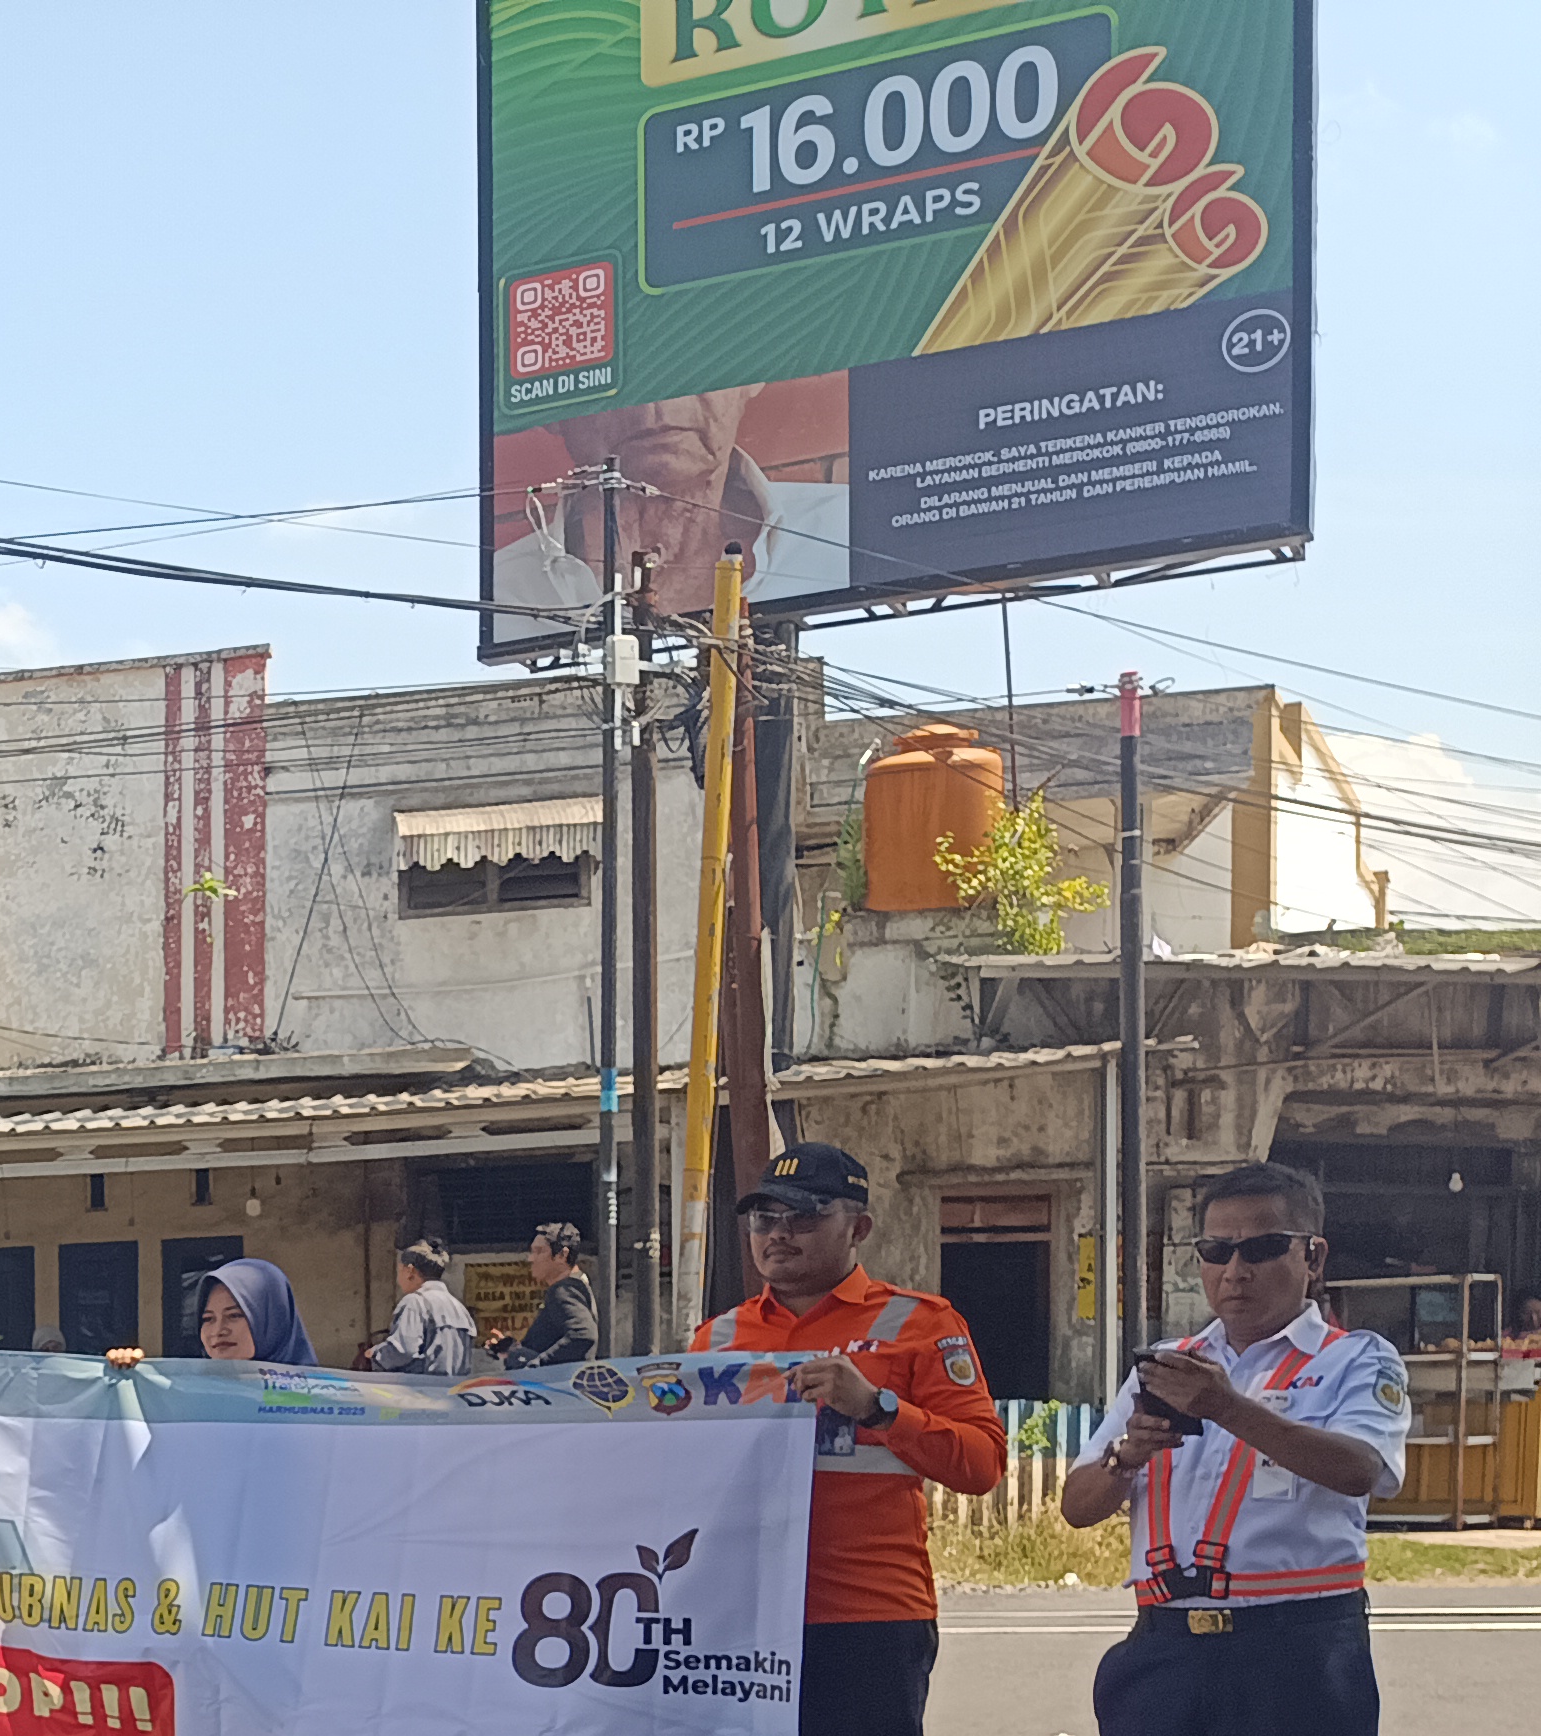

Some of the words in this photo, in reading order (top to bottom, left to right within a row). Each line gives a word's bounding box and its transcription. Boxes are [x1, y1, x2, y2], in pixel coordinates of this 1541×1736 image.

[676, 117, 726, 154] RP
[740, 45, 1059, 194] 16.000
[760, 219, 803, 254] 12
[817, 182, 981, 243] WRAPS
[1231, 328, 1285, 356] 21+
[510, 378, 554, 403] SCAN
[558, 374, 575, 393] DI
[578, 366, 611, 389] SINI
[978, 380, 1164, 430] PERINGATAN:
[868, 462, 923, 482] KARENA
[1000, 443, 1036, 460] SAYA
[1038, 432, 1104, 454] TERKENA
[1107, 422, 1165, 442] KANKER
[1168, 402, 1285, 433] TENGGOROKAN.
[916, 468, 979, 488] LAYANAN
[981, 456, 1049, 478] BERHENTI
[1051, 443, 1123, 467] MEROKOK
[891, 510, 939, 528] ORANG
[942, 506, 956, 519] DI
[959, 499, 1009, 517] BAWAH
[1011, 496, 1025, 509] 21
[1029, 488, 1077, 506] TAHUN
[1082, 482, 1113, 499] DAN
[1116, 467, 1205, 492] PEREMPUAN
[1207, 459, 1258, 478] HAMIL.
[920, 487, 988, 509] DILARANG
[990, 477, 1055, 498] MENJUAL
[1058, 470, 1089, 488] DAN
[1090, 460, 1157, 482] MEMBERI
[1163, 450, 1222, 470] KEPADA
[458, 1389, 552, 1407] DJKA
[151, 1578, 182, 1635] &
[201, 1582, 309, 1644] HUT
[324, 1590, 416, 1652] KAI
[433, 1594, 502, 1656] KE
[663, 1650, 792, 1676] Semakin
[663, 1675, 792, 1703] Melayani
